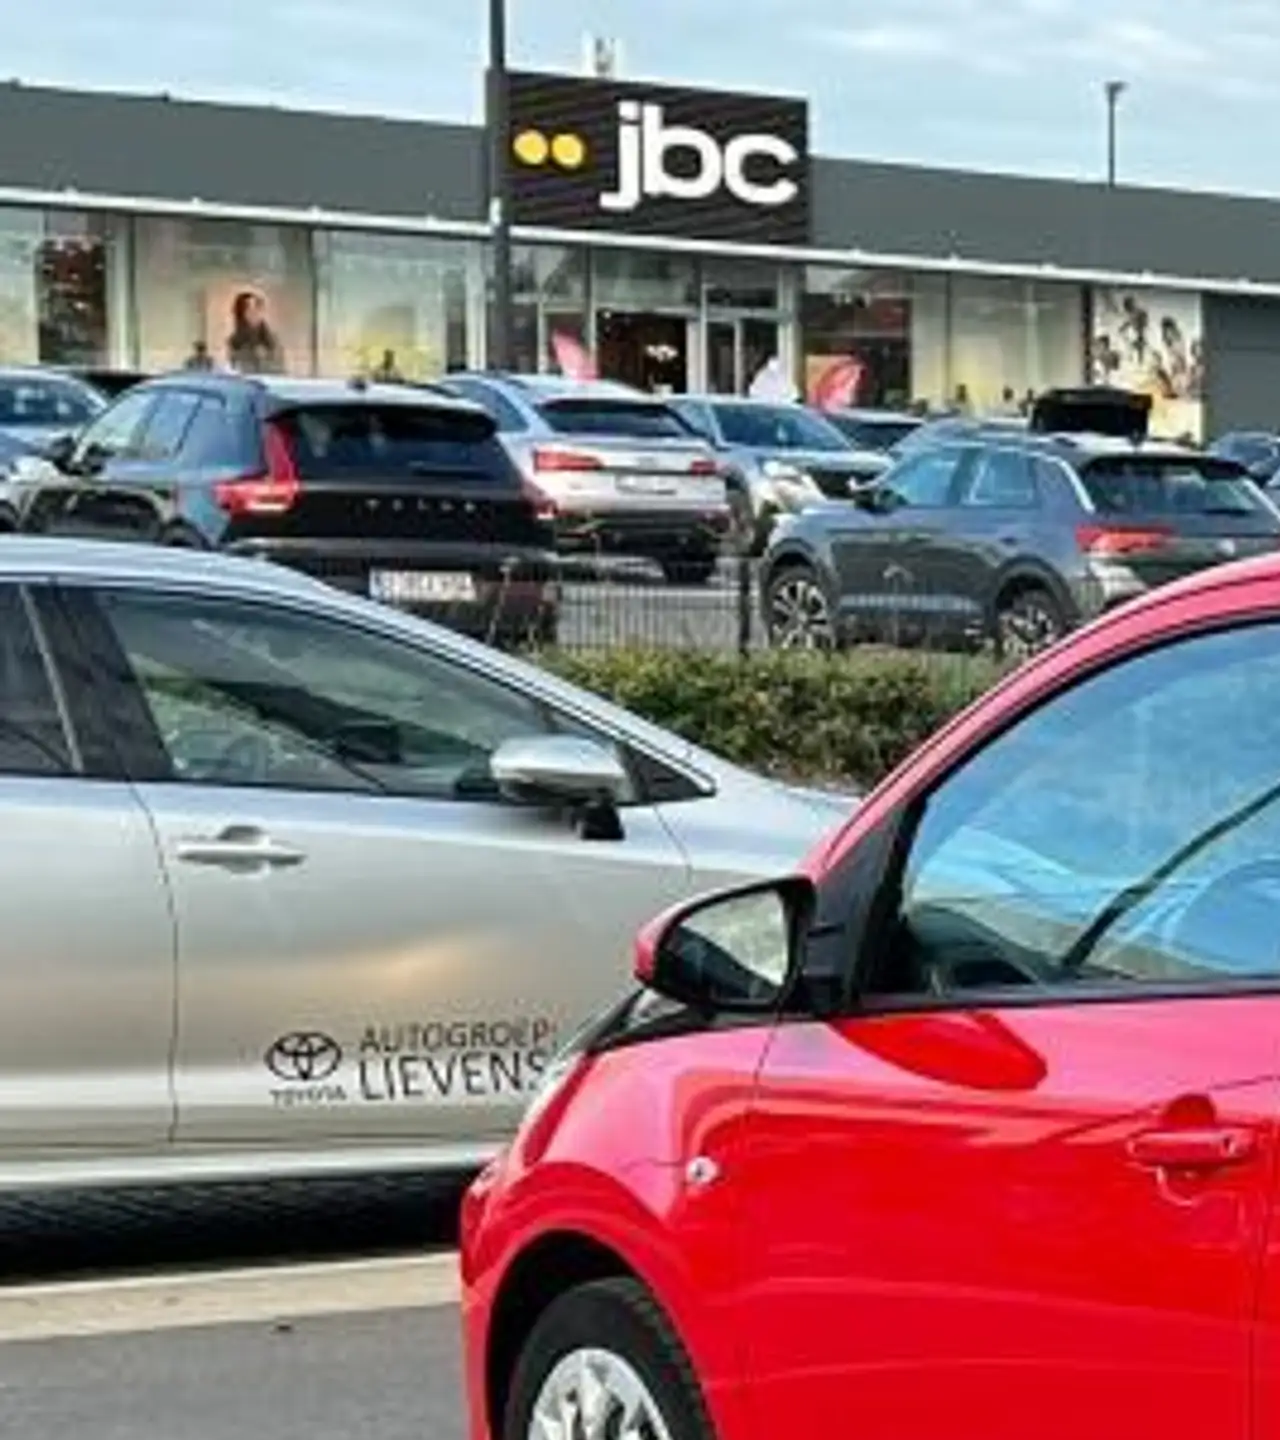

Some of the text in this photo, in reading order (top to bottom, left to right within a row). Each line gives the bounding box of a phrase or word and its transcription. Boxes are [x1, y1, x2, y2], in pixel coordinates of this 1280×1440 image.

[600, 100, 798, 212] jbc
[360, 1018, 551, 1053] AUTOGROEP
[359, 1050, 549, 1101] LIEVENS
